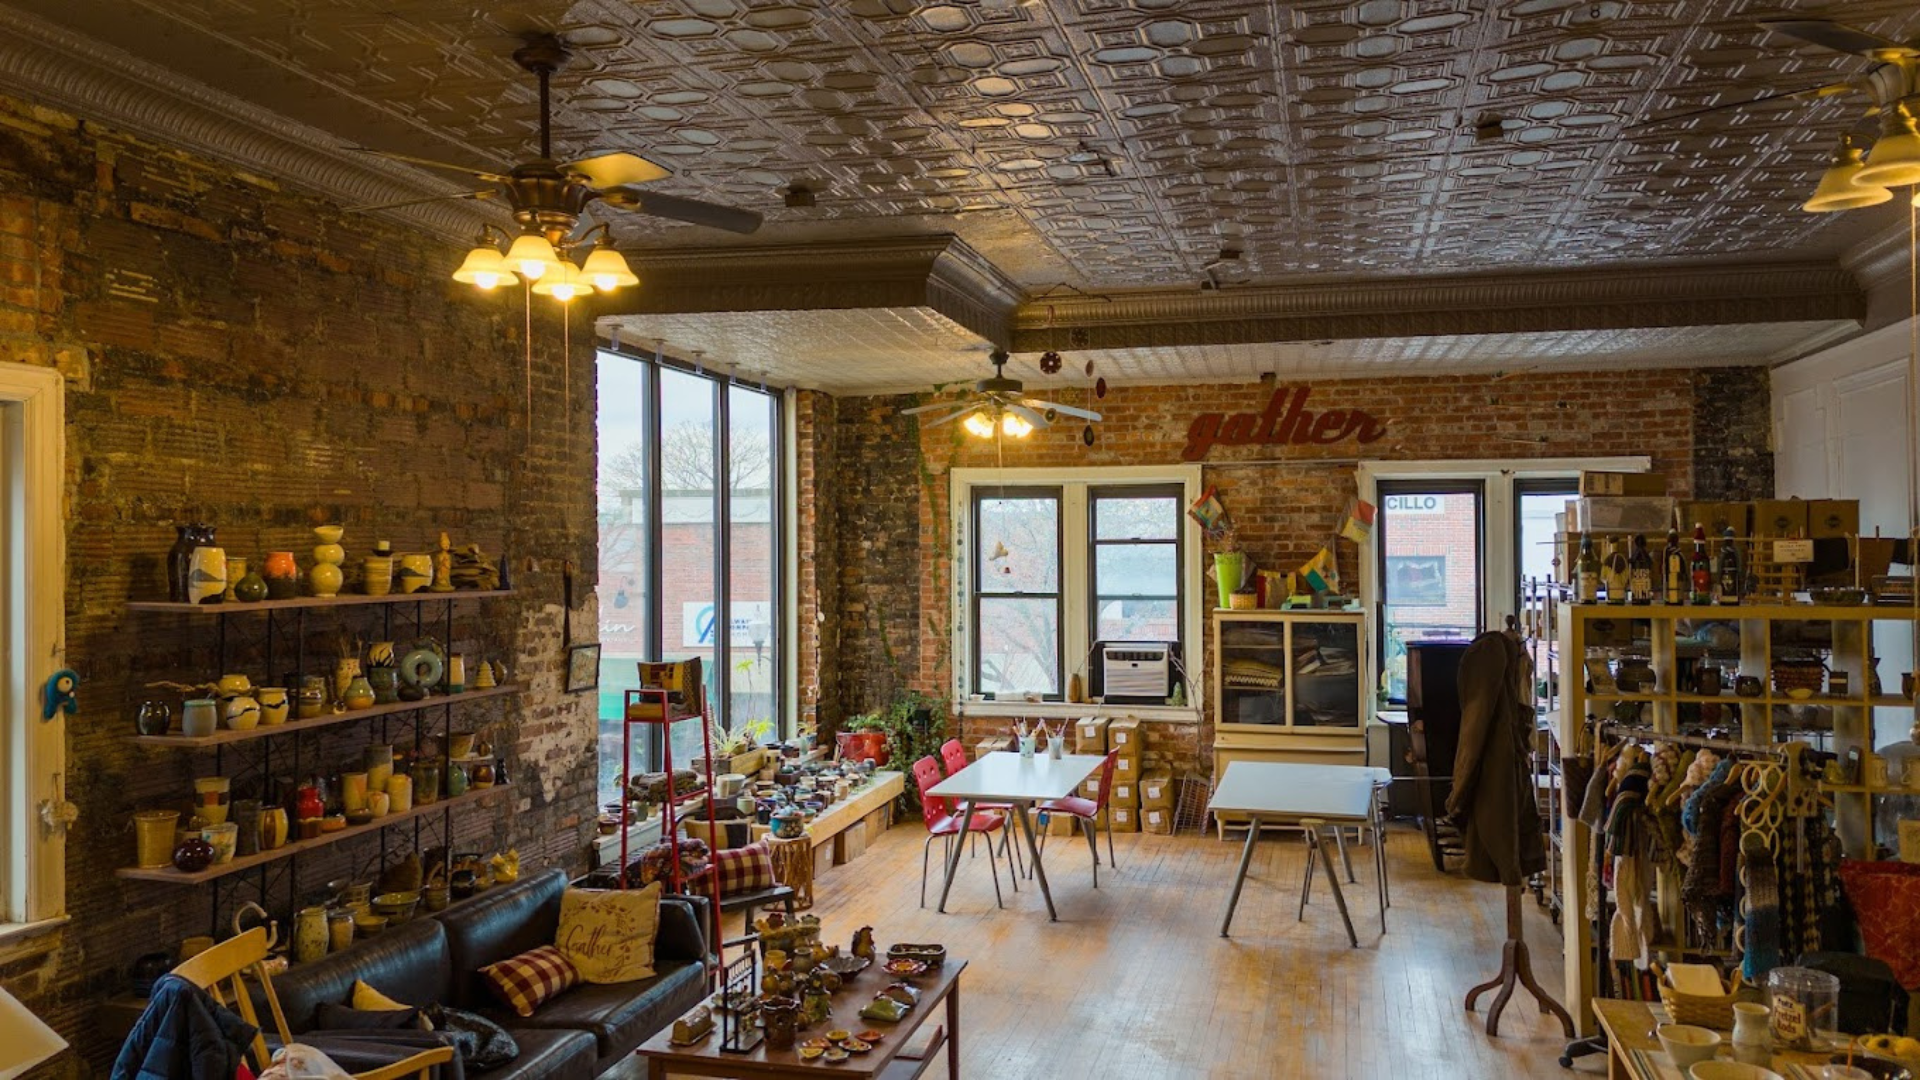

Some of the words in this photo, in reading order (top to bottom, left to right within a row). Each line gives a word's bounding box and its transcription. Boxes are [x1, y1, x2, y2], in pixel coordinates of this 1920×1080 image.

[1181, 386, 1387, 461] gather
[1387, 496, 1437, 509] CILLO
[565, 923, 612, 960] Gather
